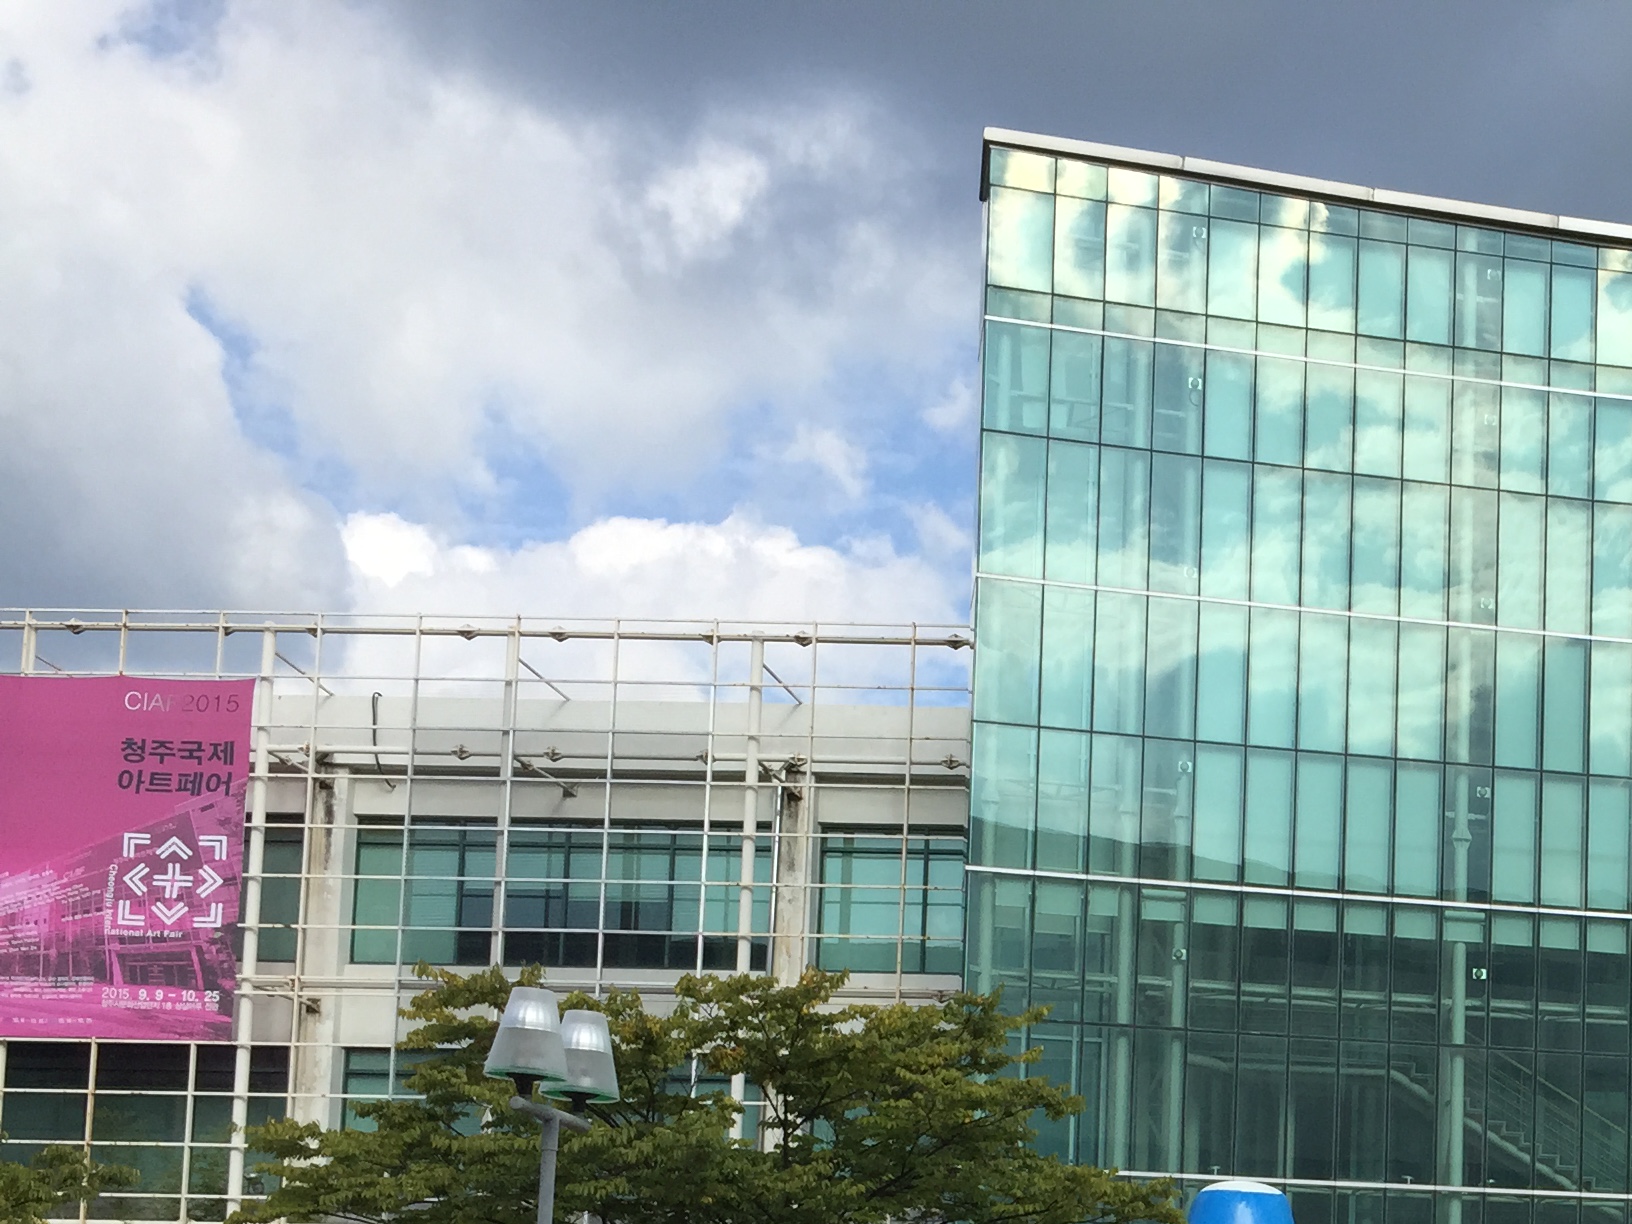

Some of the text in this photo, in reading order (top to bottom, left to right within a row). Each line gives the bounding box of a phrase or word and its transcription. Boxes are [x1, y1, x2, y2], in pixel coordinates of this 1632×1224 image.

[182, 693, 240, 713] 2015
[121, 738, 235, 766] 청주국제
[117, 769, 233, 797] 아트페어
[146, 929, 161, 938] Art
[204, 991, 220, 1002] 25
